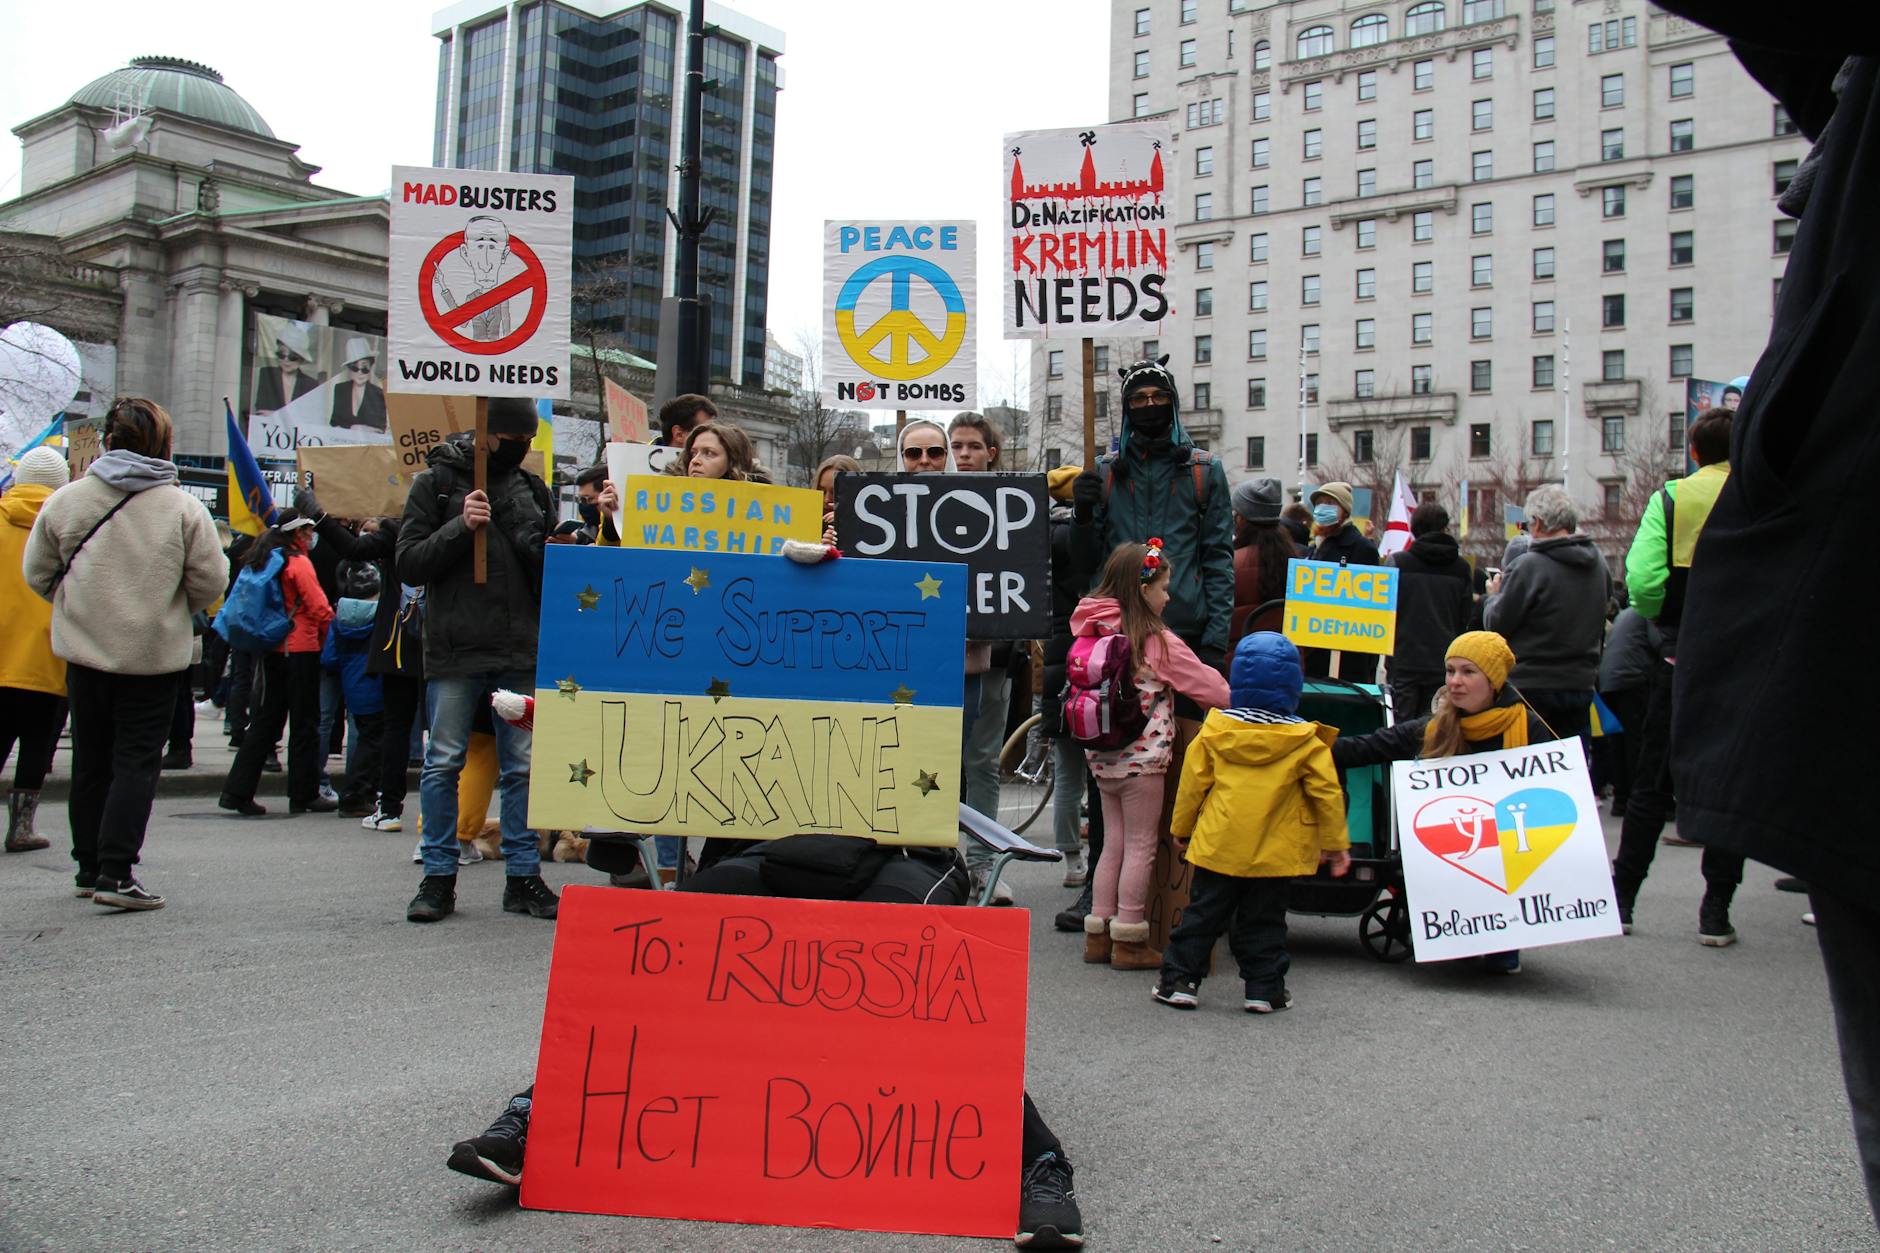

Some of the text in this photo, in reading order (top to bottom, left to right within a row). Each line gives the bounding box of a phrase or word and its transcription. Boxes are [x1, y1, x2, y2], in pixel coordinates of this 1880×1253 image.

[403, 182, 557, 213] MADBUSTERS
[840, 226, 958, 254] PEACE
[1012, 228, 1167, 274] KREMLIN
[1014, 273, 1169, 328] NEEDS
[398, 359, 558, 386] WORLD NEEDS
[838, 379, 966, 403] NOT BOMBS
[400, 428, 441, 448] clas
[636, 489, 791, 525] RUSSIAN
[855, 484, 1036, 555] STOP
[966, 570, 1031, 614] ER
[1295, 566, 1389, 604] PEACE
[1291, 616, 1386, 639] I DEMAND
[602, 700, 900, 834] UKRAINE
[1408, 750, 1573, 791] STOP WAR
[1421, 909, 1508, 941] Belarus
[763, 1077, 986, 1180] Войне
